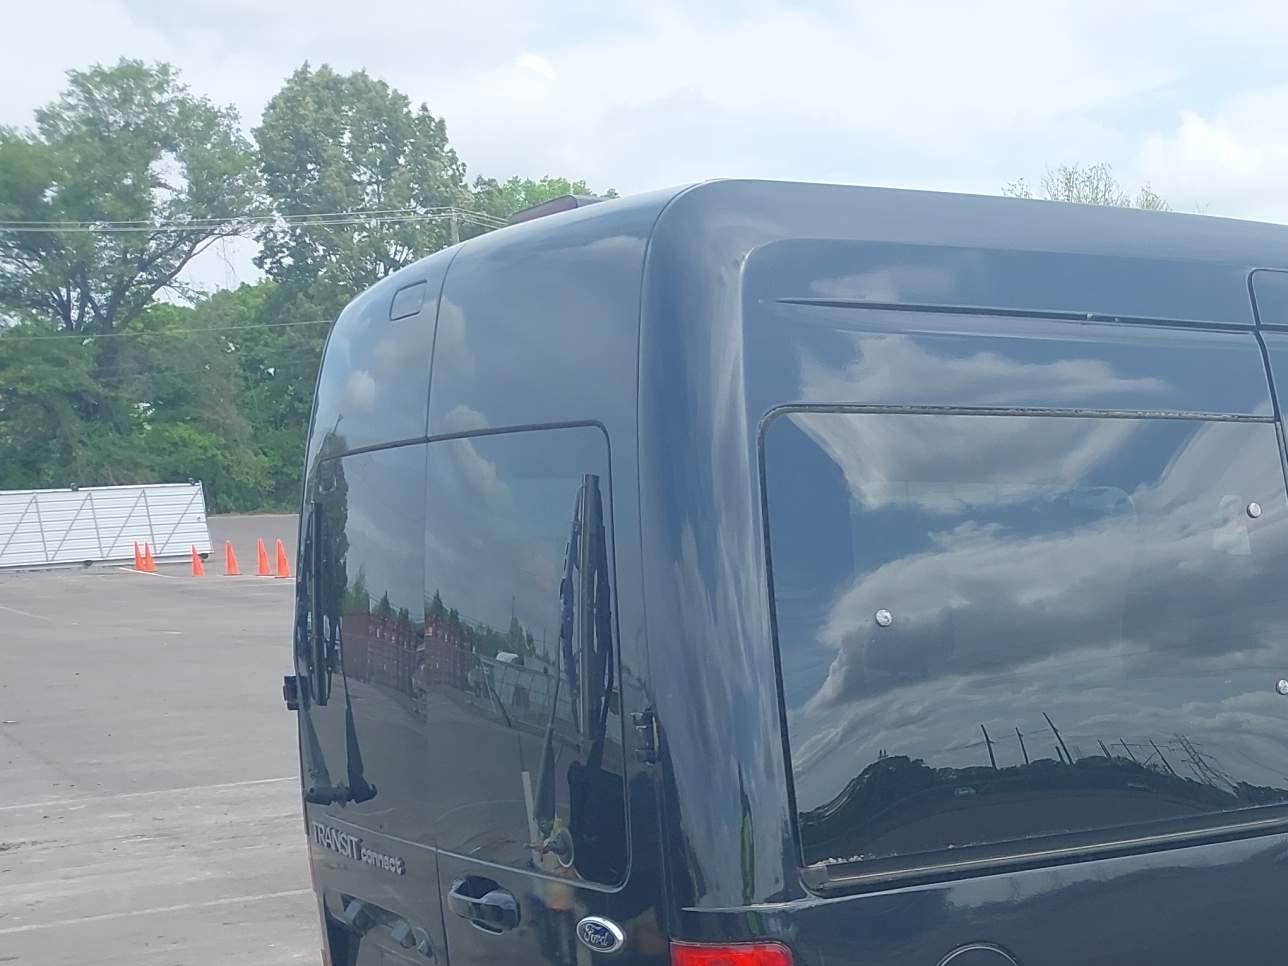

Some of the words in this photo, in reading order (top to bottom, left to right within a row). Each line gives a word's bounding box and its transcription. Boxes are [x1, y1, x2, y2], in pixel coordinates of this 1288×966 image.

[312, 820, 361, 861] TRANSIT
[360, 846, 406, 875] connect
[583, 923, 609, 947] Ford
